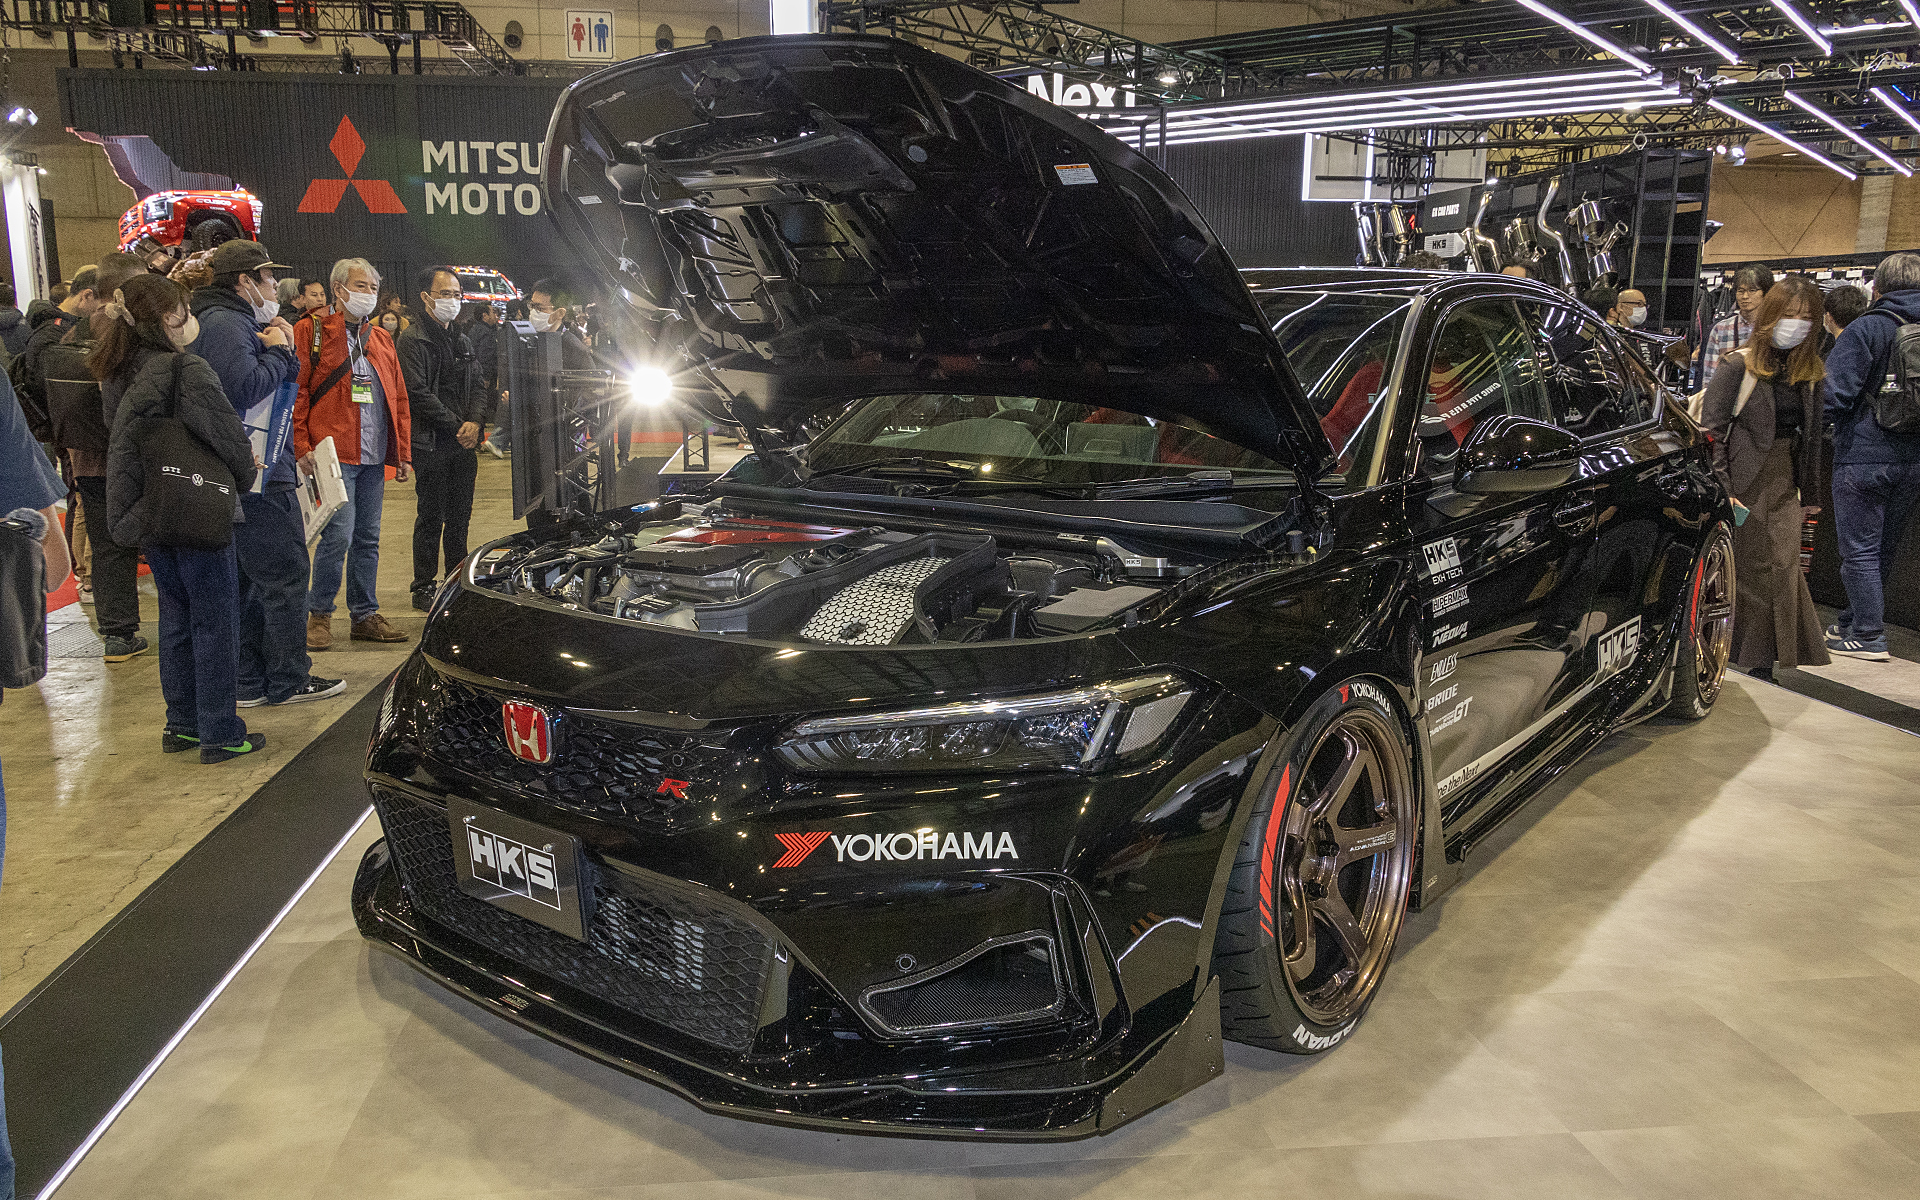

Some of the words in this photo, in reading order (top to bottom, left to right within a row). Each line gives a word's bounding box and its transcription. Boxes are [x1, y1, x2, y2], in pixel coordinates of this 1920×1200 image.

[422, 140, 544, 175] MITSU
[425, 182, 541, 216] MOTO
[1432, 239, 1447, 250] HKS
[1424, 540, 1456, 565] HKS
[1432, 573, 1446, 585] EXH
[1599, 624, 1639, 673] HKS
[1430, 652, 1459, 681] ENDLESS
[1351, 683, 1391, 717] YOKOHAMA
[1428, 683, 1459, 711] BRIDE
[1453, 696, 1474, 724] GT
[470, 831, 556, 891] HKS
[830, 831, 1019, 862] YOKOHAMA
[1292, 1017, 1358, 1050] ADVAN
